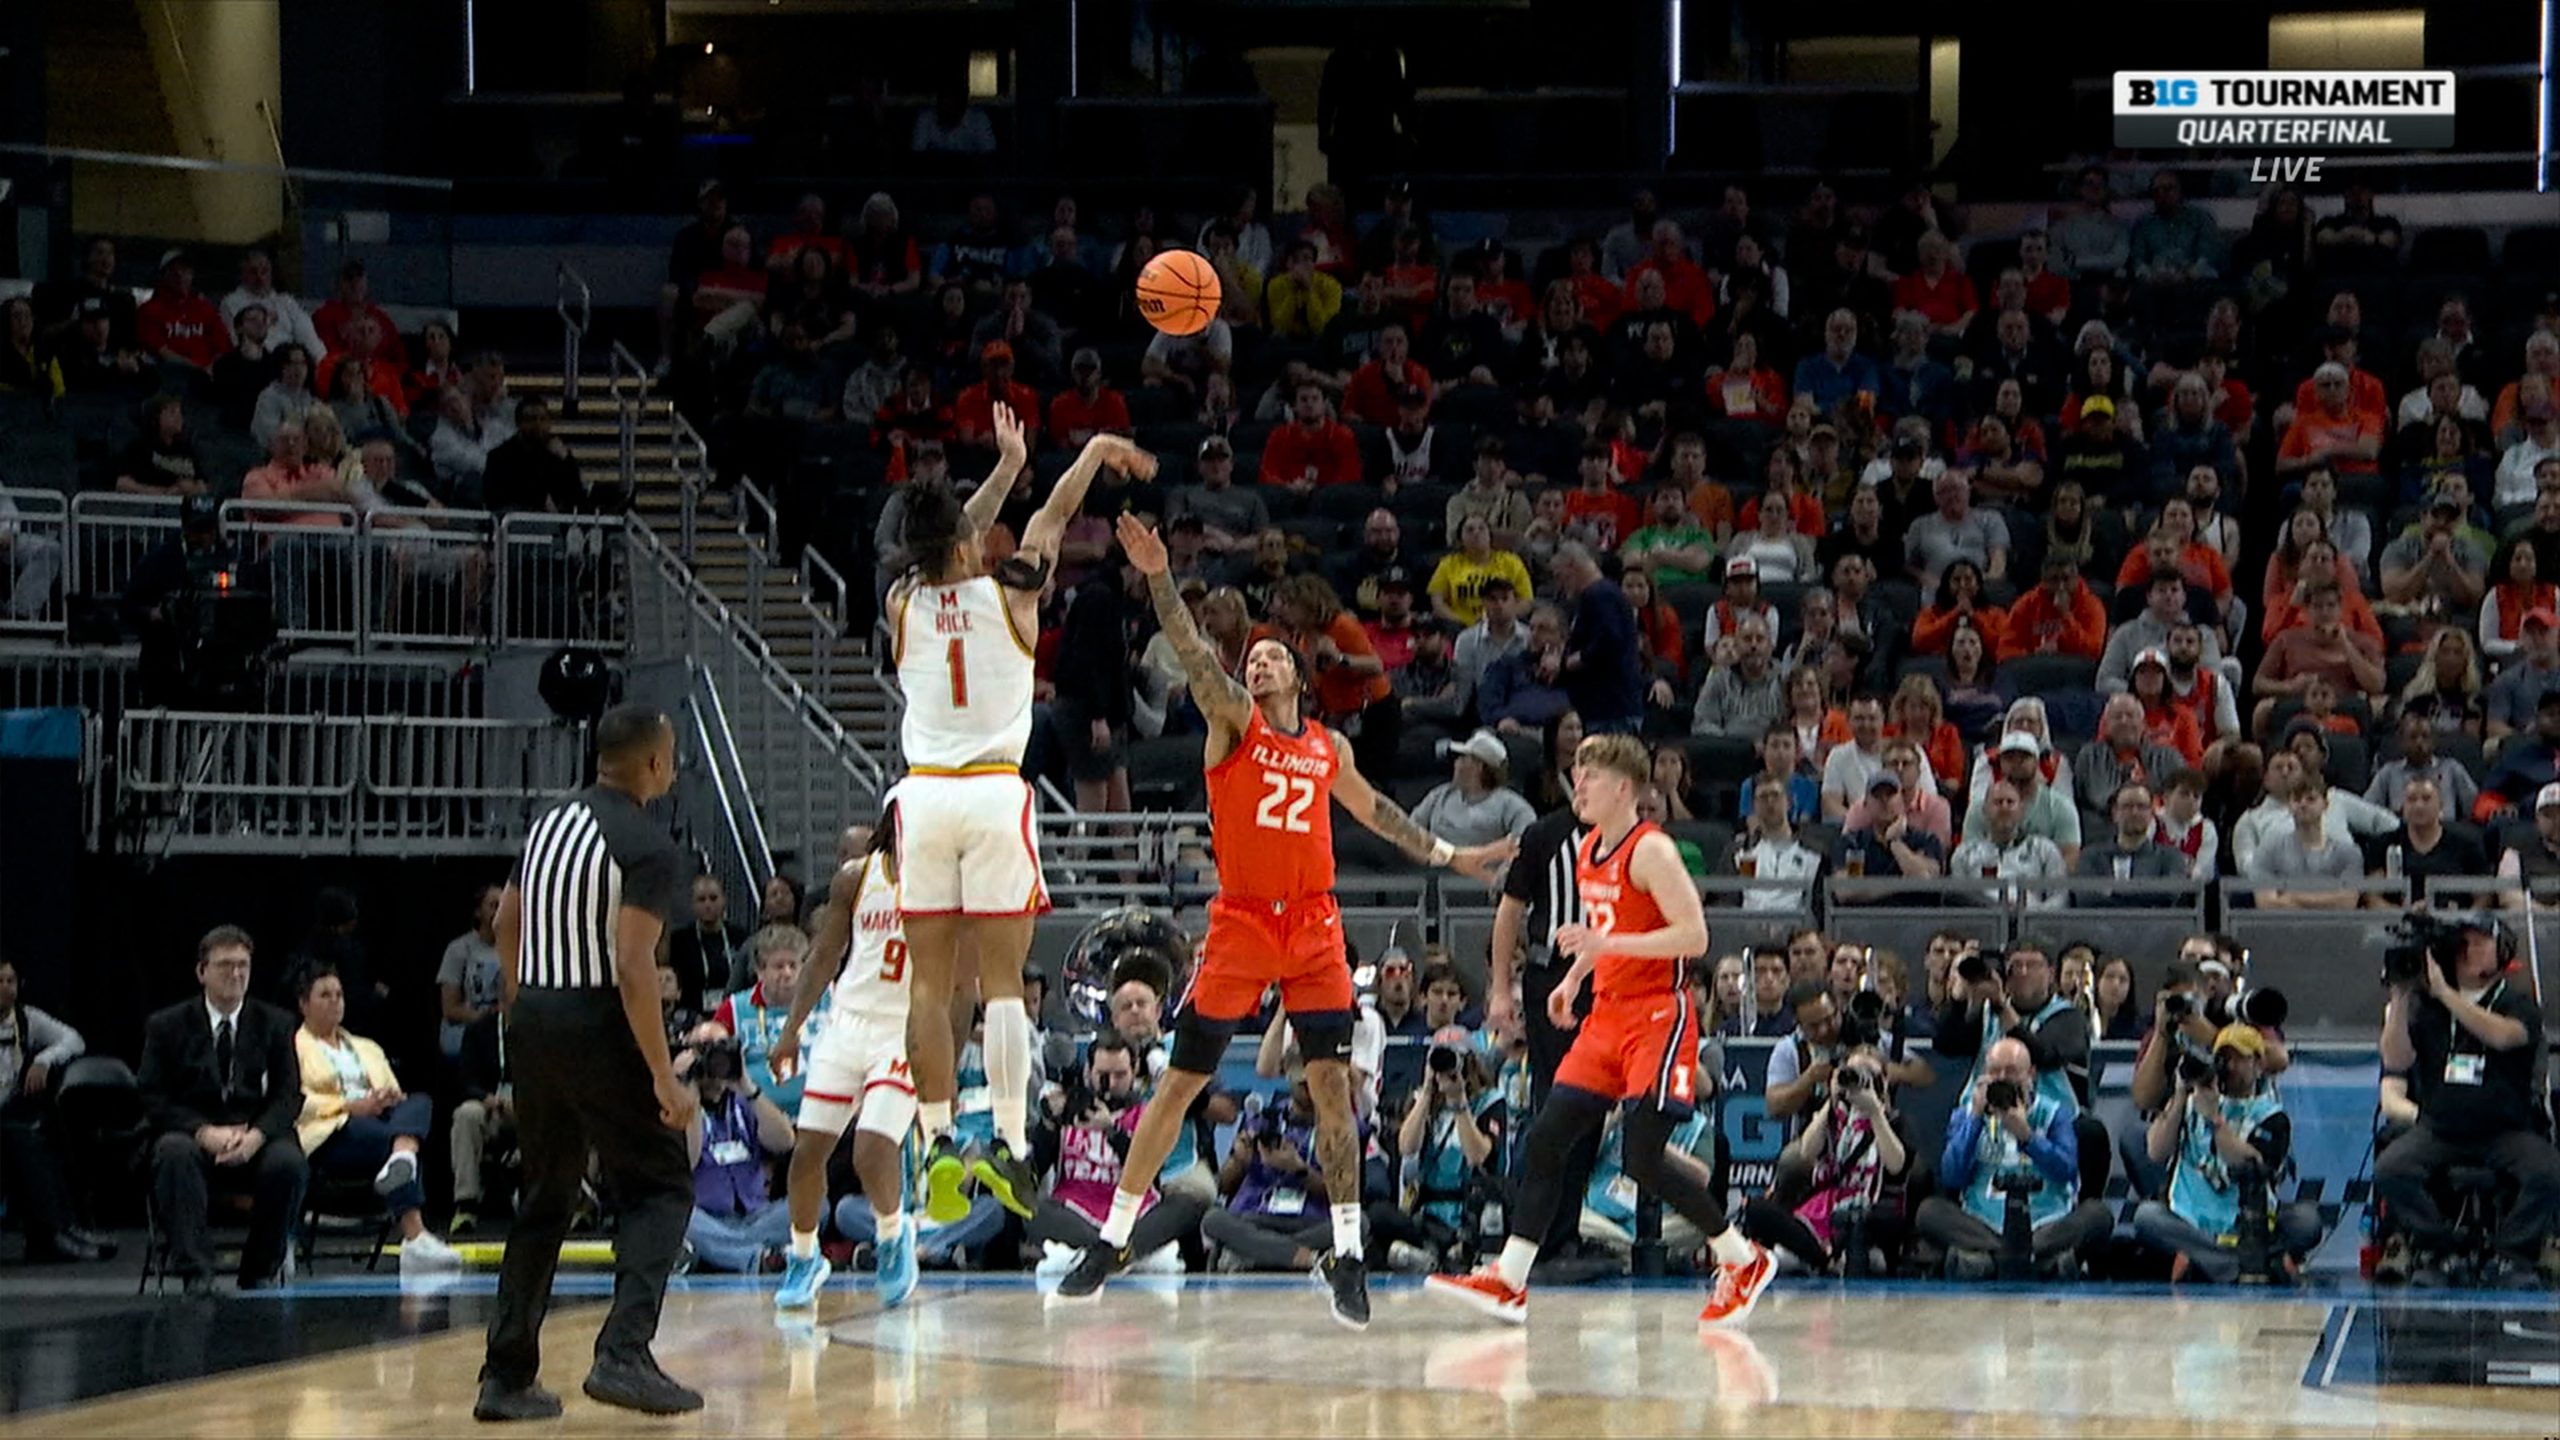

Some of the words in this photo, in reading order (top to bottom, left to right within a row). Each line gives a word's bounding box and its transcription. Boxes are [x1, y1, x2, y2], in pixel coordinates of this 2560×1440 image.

[940, 590, 958, 610] M
[936, 610, 973, 633] RICE
[946, 637, 968, 709] 1
[1251, 743, 1330, 778] ILLINOIS
[1256, 770, 1315, 834] 22
[860, 908, 902, 931] MARY
[879, 938, 907, 982] 9
[1728, 1163, 1774, 1186] URN
